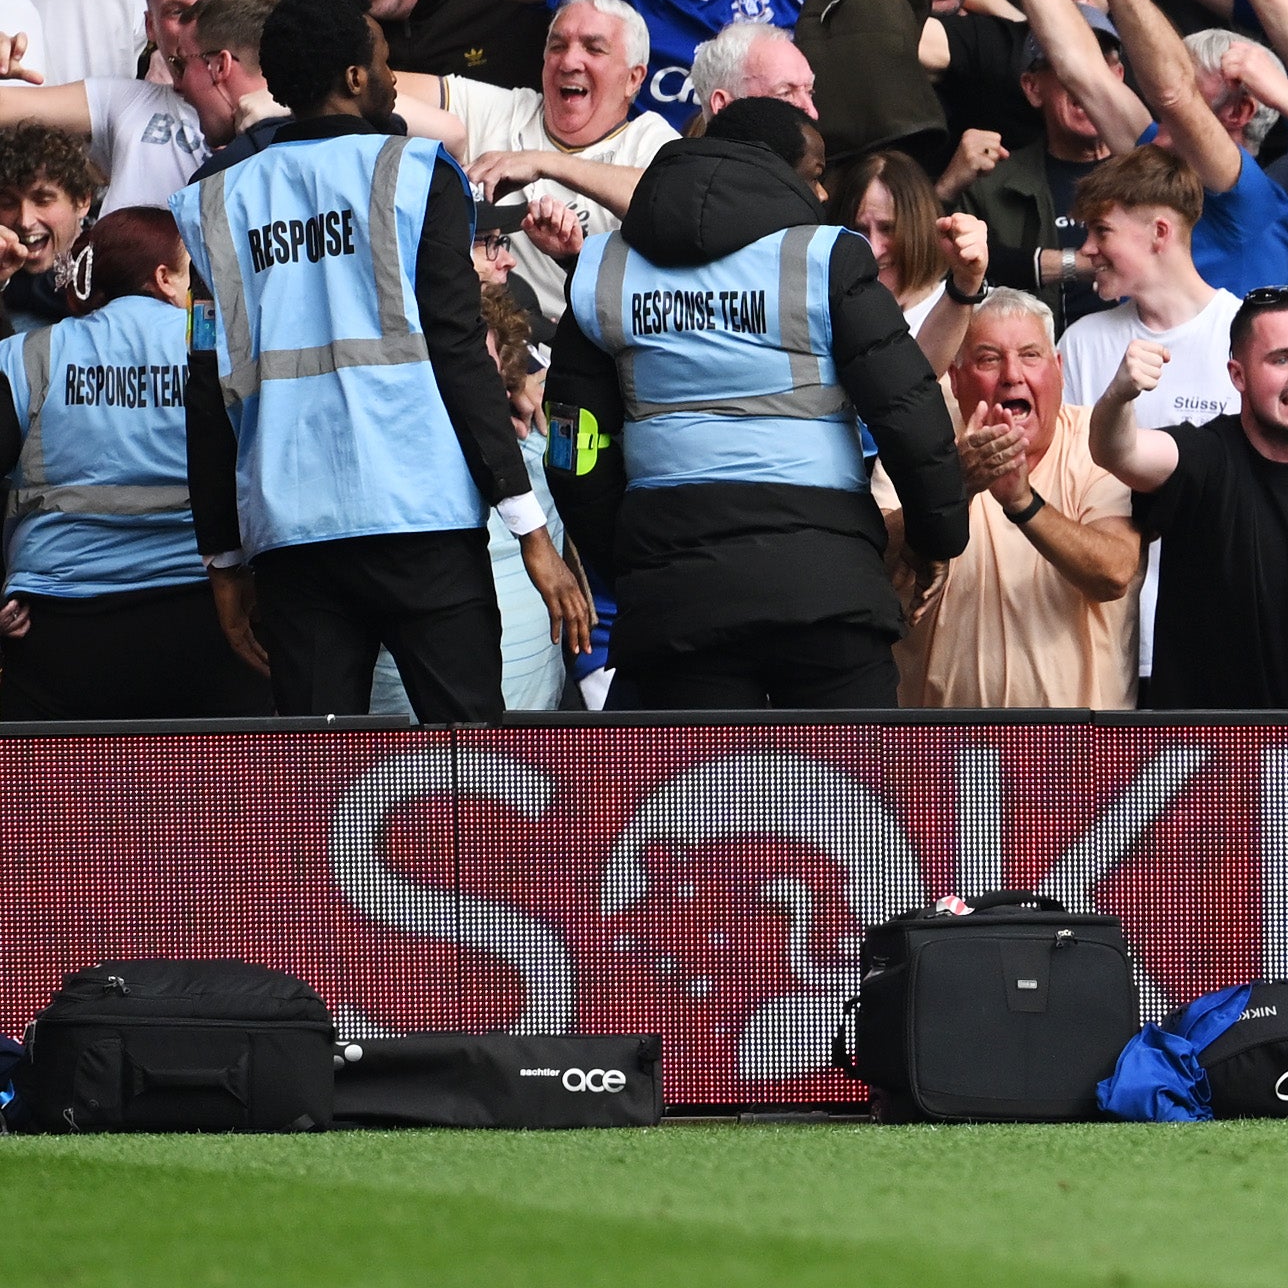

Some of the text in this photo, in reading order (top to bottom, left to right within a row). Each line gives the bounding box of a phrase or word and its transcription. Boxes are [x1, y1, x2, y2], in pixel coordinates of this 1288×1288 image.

[247, 209, 355, 274] RESPONSE
[632, 289, 767, 336] RESPONSE TEAM
[64, 363, 147, 409] RESPONSE
[1173, 395, 1228, 413] Stüssy
[519, 1067, 627, 1093] sachtler ace
